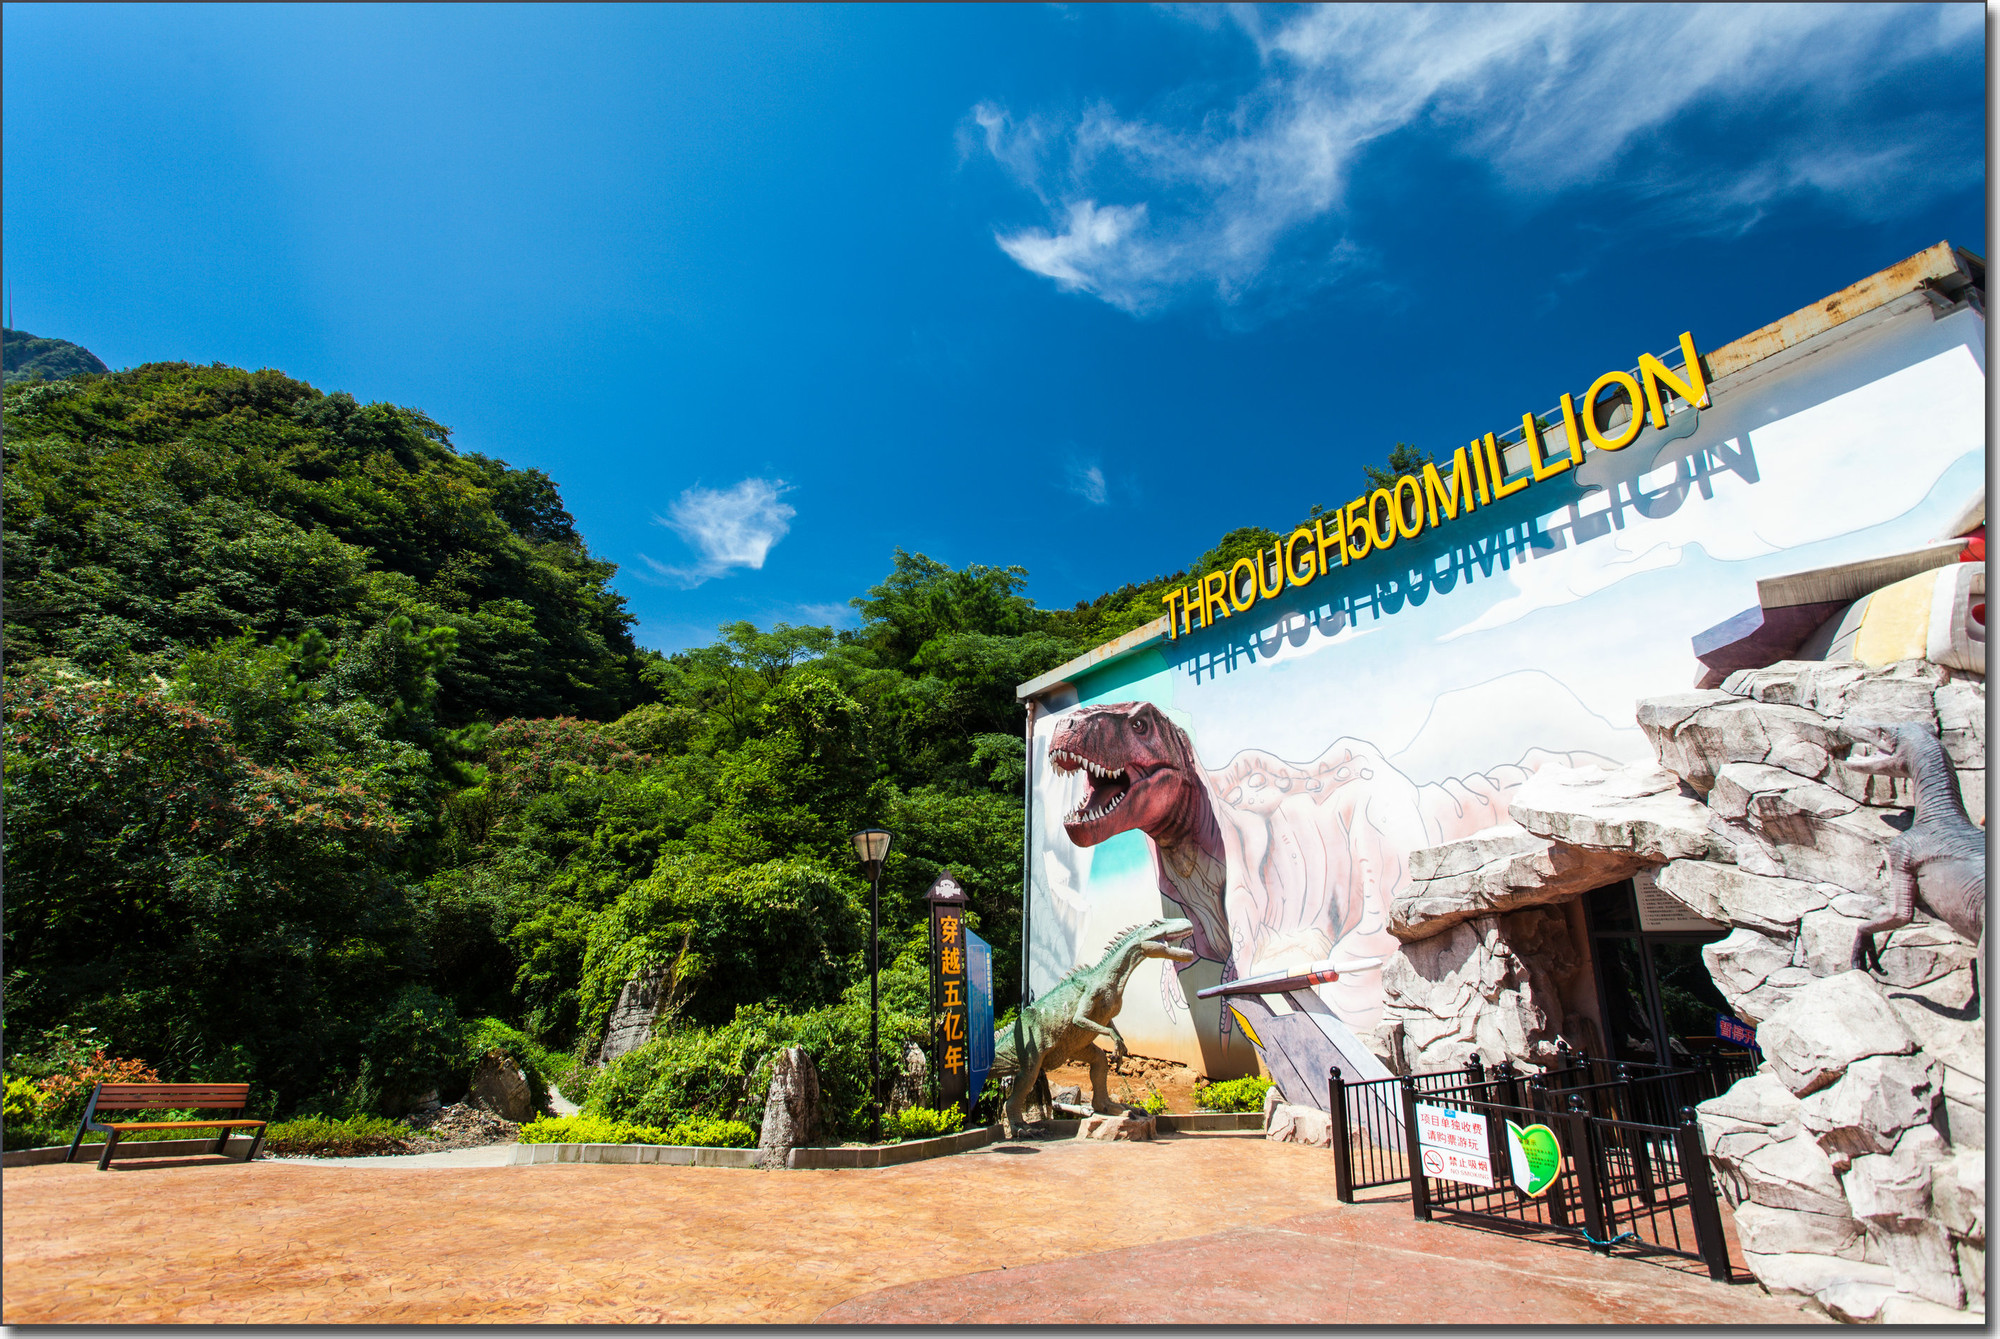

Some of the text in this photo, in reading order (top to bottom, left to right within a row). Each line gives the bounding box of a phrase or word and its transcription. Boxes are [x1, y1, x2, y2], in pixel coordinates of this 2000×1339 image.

[940, 915, 964, 1075] 穿越五亿年
[1720, 1020, 1759, 1047] 暂停开
[1421, 1113, 1482, 1135] 项目单独收费
[1427, 1130, 1479, 1150] 请购票游玩
[1449, 1155, 1488, 1172] 禁止吸烟
[1460, 1170, 1489, 1180] SMOKING
